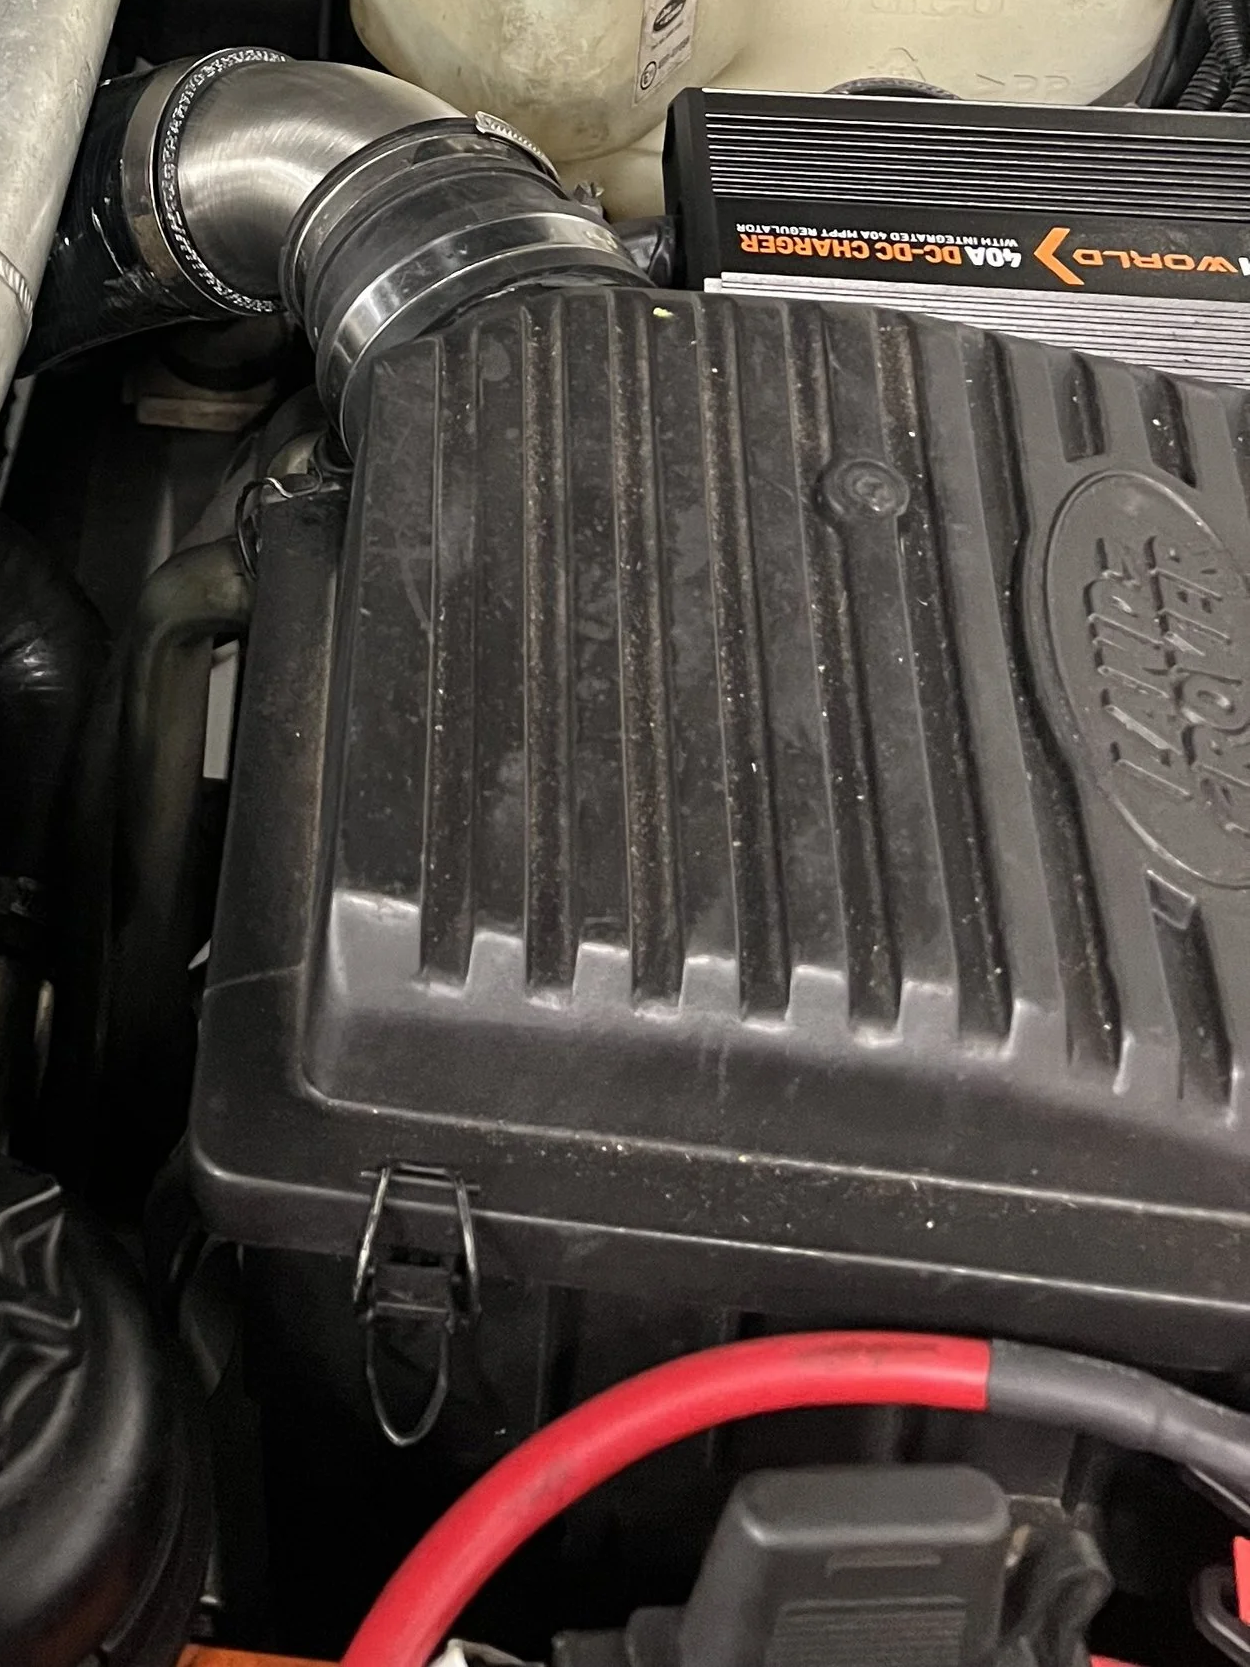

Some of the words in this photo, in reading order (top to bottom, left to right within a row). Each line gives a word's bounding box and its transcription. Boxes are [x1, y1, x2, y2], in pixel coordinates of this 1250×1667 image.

[735, 223, 818, 237] REGULATOR
[820, 228, 858, 239] MPPT
[860, 230, 888, 241] 40A
[740, 233, 870, 259] CHARGER
[890, 232, 978, 246] INTEGRATED
[980, 237, 1019, 248] WITH
[875, 243, 963, 265] DC-DC
[963, 245, 1022, 268] 40A
[1072, 248, 1250, 276] WORLD
